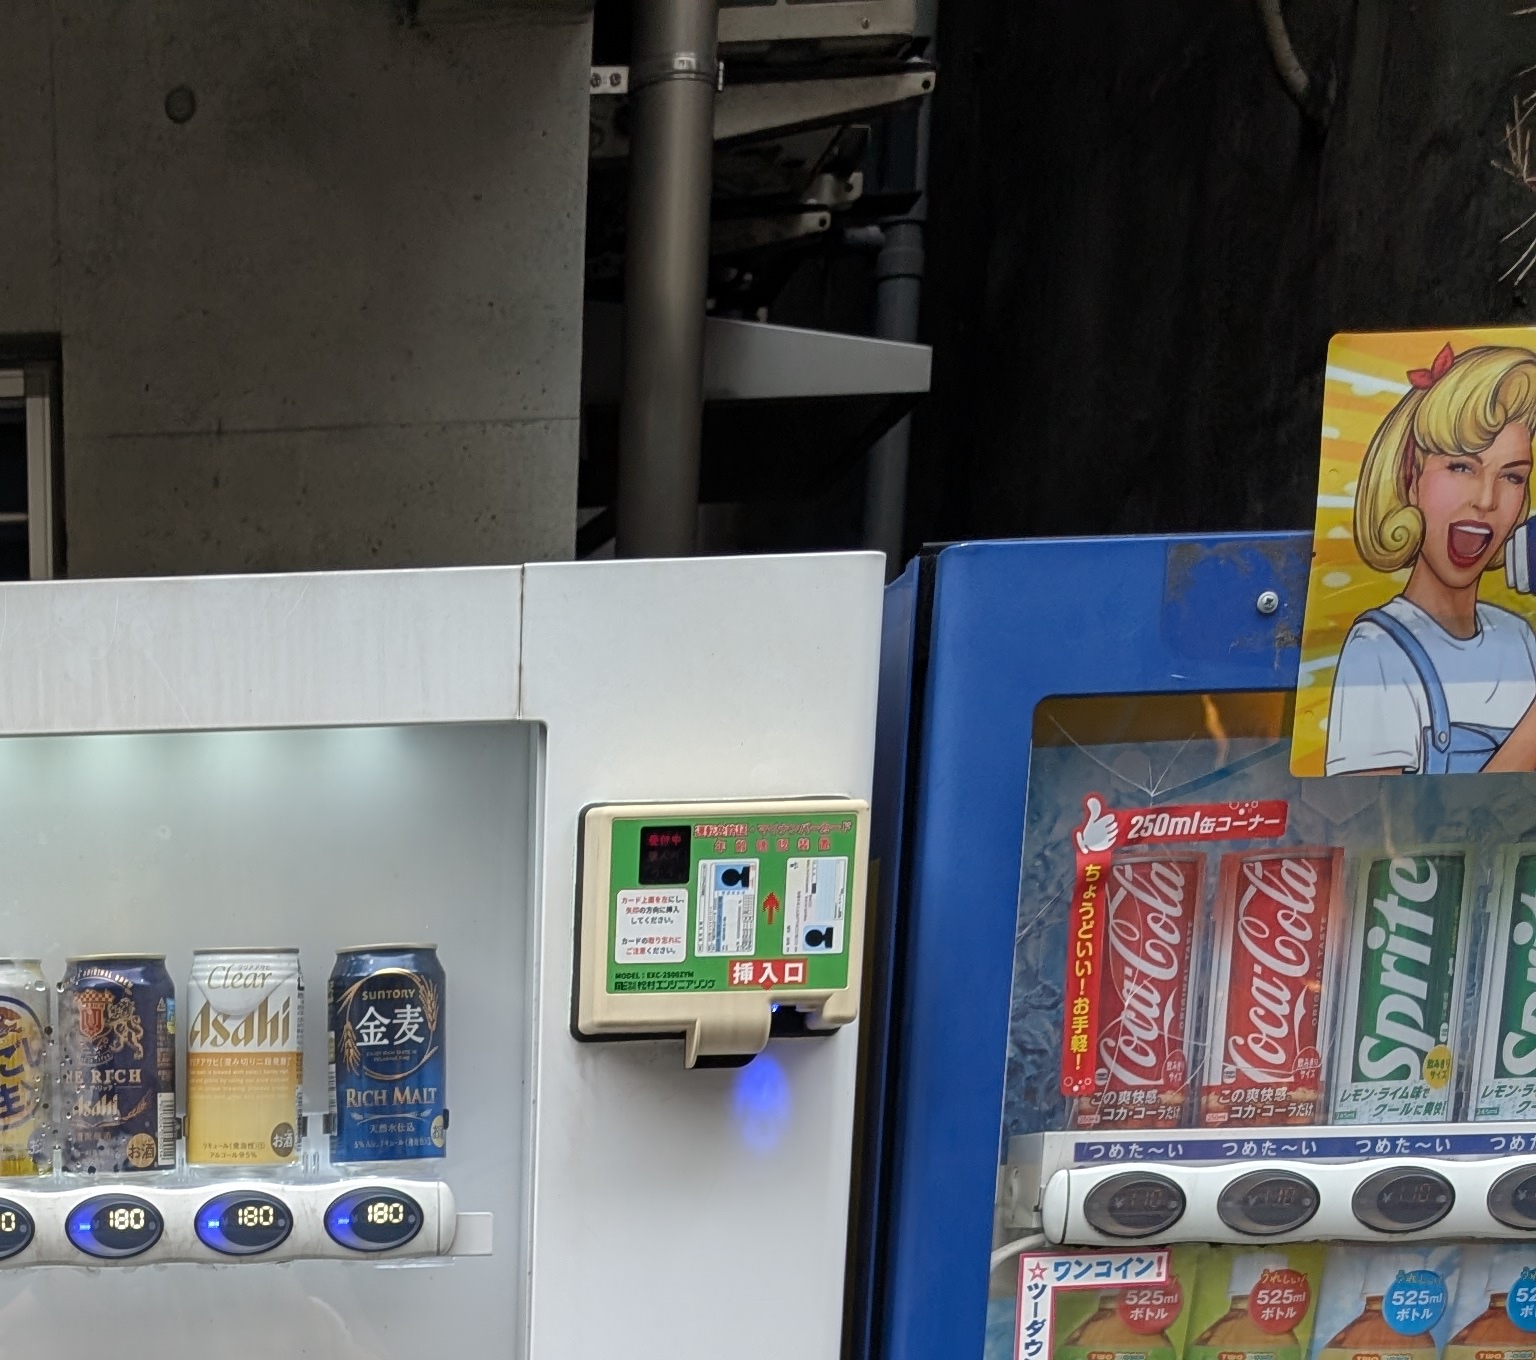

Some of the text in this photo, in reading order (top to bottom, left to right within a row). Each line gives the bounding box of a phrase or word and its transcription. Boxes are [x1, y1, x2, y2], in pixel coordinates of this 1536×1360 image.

[1127, 811, 1280, 840] 250ml缶コーナー
[208, 965, 272, 991] Clear
[732, 961, 804, 985] 挿入口
[1358, 856, 1440, 1083] Sprite
[362, 988, 416, 1001] SUNTORY
[189, 997, 291, 1048] Asahi
[355, 1005, 425, 1047] 金麦
[345, 1086, 438, 1108] RICH MALT
[238, 1205, 274, 1227] 180
[368, 1202, 404, 1224] 180
[1053, 1256, 1164, 1282] ワンコイン!
